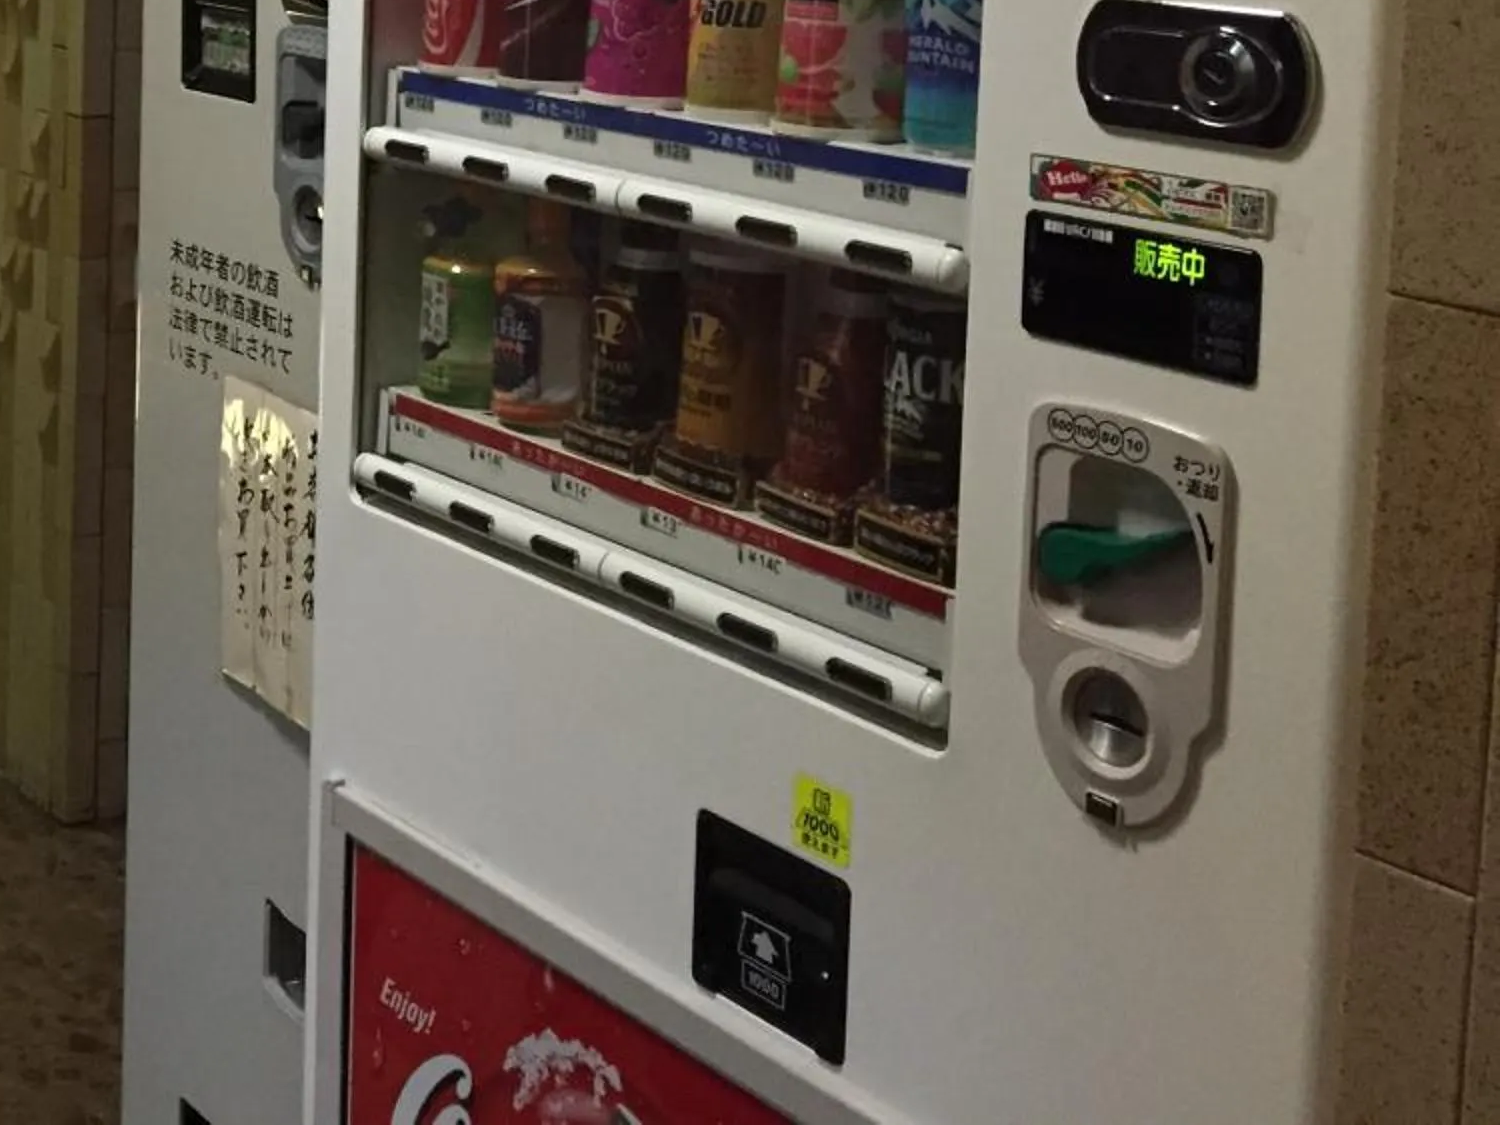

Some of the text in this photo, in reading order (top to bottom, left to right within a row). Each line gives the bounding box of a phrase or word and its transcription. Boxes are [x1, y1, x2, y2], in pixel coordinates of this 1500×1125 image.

[169, 240, 280, 299] 未成年者の飲酒
[1134, 239, 1206, 286] 販売中
[169, 272, 294, 339] および飲酒運転は
[169, 337, 219, 380] います。
[1051, 416, 1144, 453] 500 100 50 10
[1173, 455, 1221, 482] おつり
[378, 976, 437, 1036] Enjoy!
[748, 971, 780, 1001] 1000
